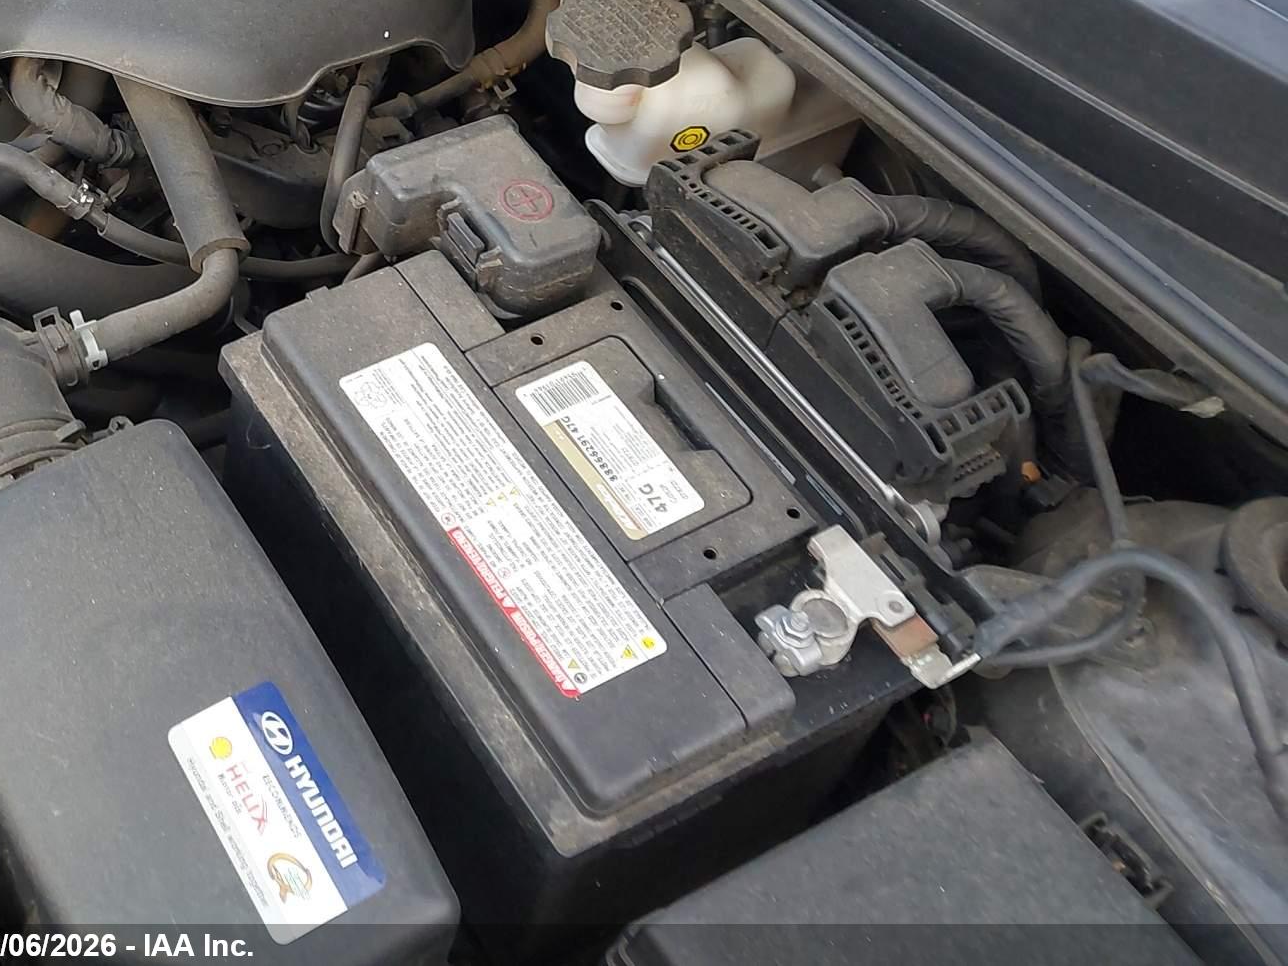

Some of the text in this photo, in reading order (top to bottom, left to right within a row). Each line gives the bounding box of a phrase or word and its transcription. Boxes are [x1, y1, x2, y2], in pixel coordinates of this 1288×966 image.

[637, 481, 670, 512] 47G
[224, 763, 269, 836] HELIX
[283, 752, 359, 870] HYUNDAI
